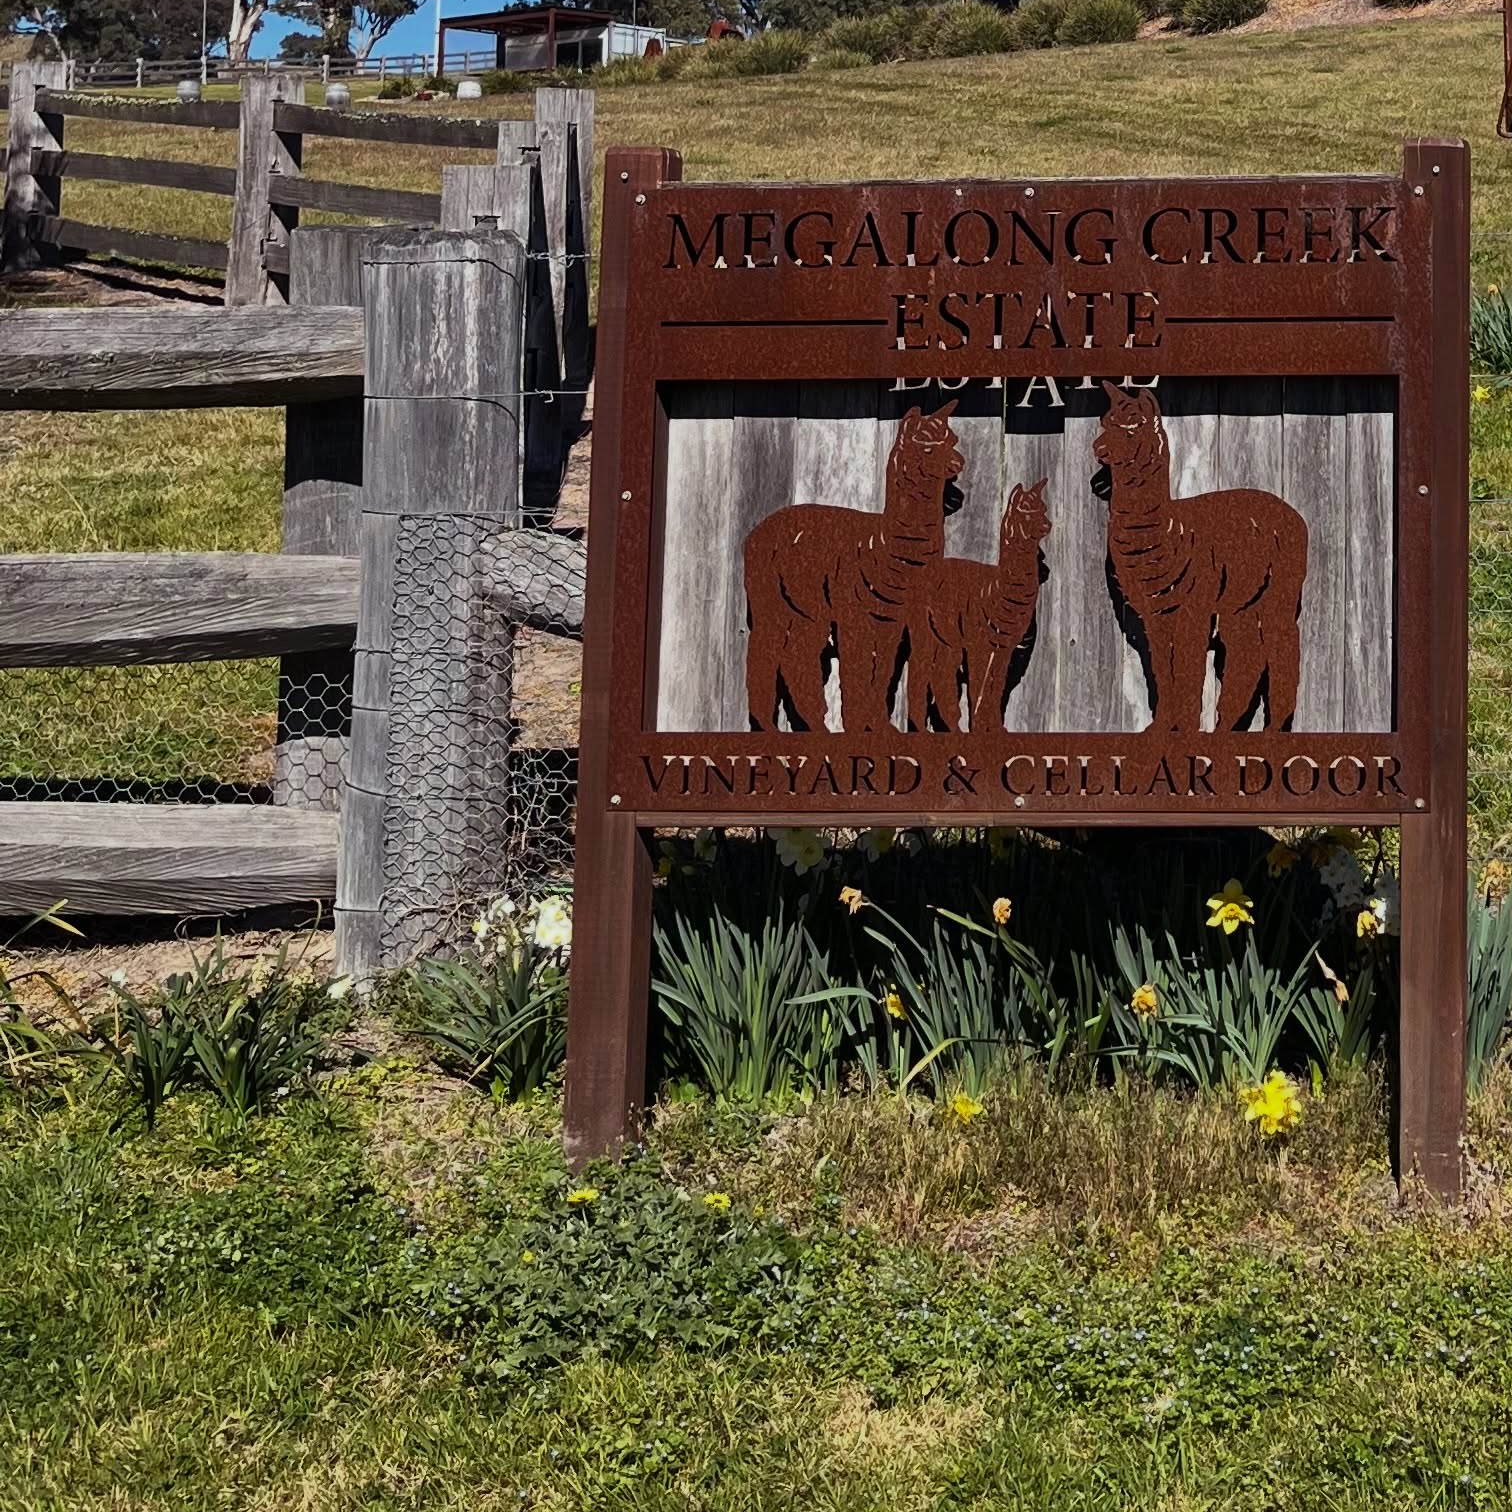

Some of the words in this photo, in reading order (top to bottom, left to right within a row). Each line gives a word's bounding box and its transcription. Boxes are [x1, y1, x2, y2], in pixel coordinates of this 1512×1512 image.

[662, 208, 1118, 269] MEGALONG
[1142, 206, 1398, 265] CREEK
[888, 290, 1162, 350] ESTATE
[639, 754, 923, 796] VINEYARD
[942, 754, 982, 796] &
[1000, 754, 1218, 797] CELLAR
[1234, 754, 1408, 797] DOOR
